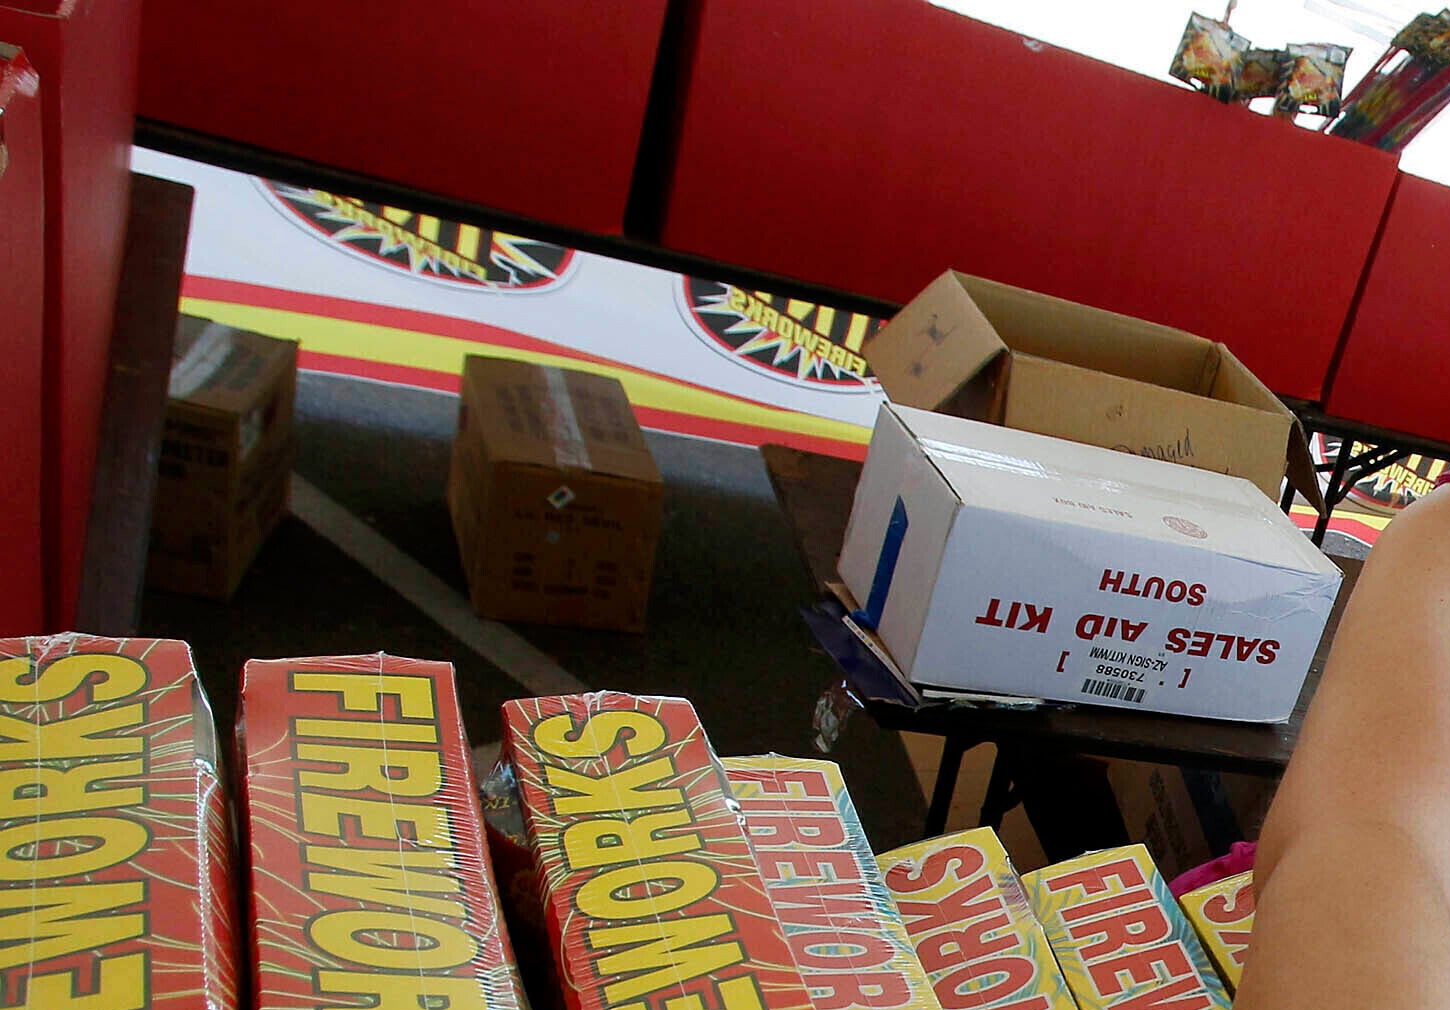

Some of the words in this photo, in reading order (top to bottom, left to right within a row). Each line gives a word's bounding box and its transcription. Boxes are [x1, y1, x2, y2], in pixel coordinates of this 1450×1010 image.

[1099, 568, 1208, 607] SOUTH
[975, 598, 1054, 634] KIT
[1075, 613, 1149, 642] AID
[1166, 627, 1281, 665] SALES
[1095, 664, 1146, 683] 730588
